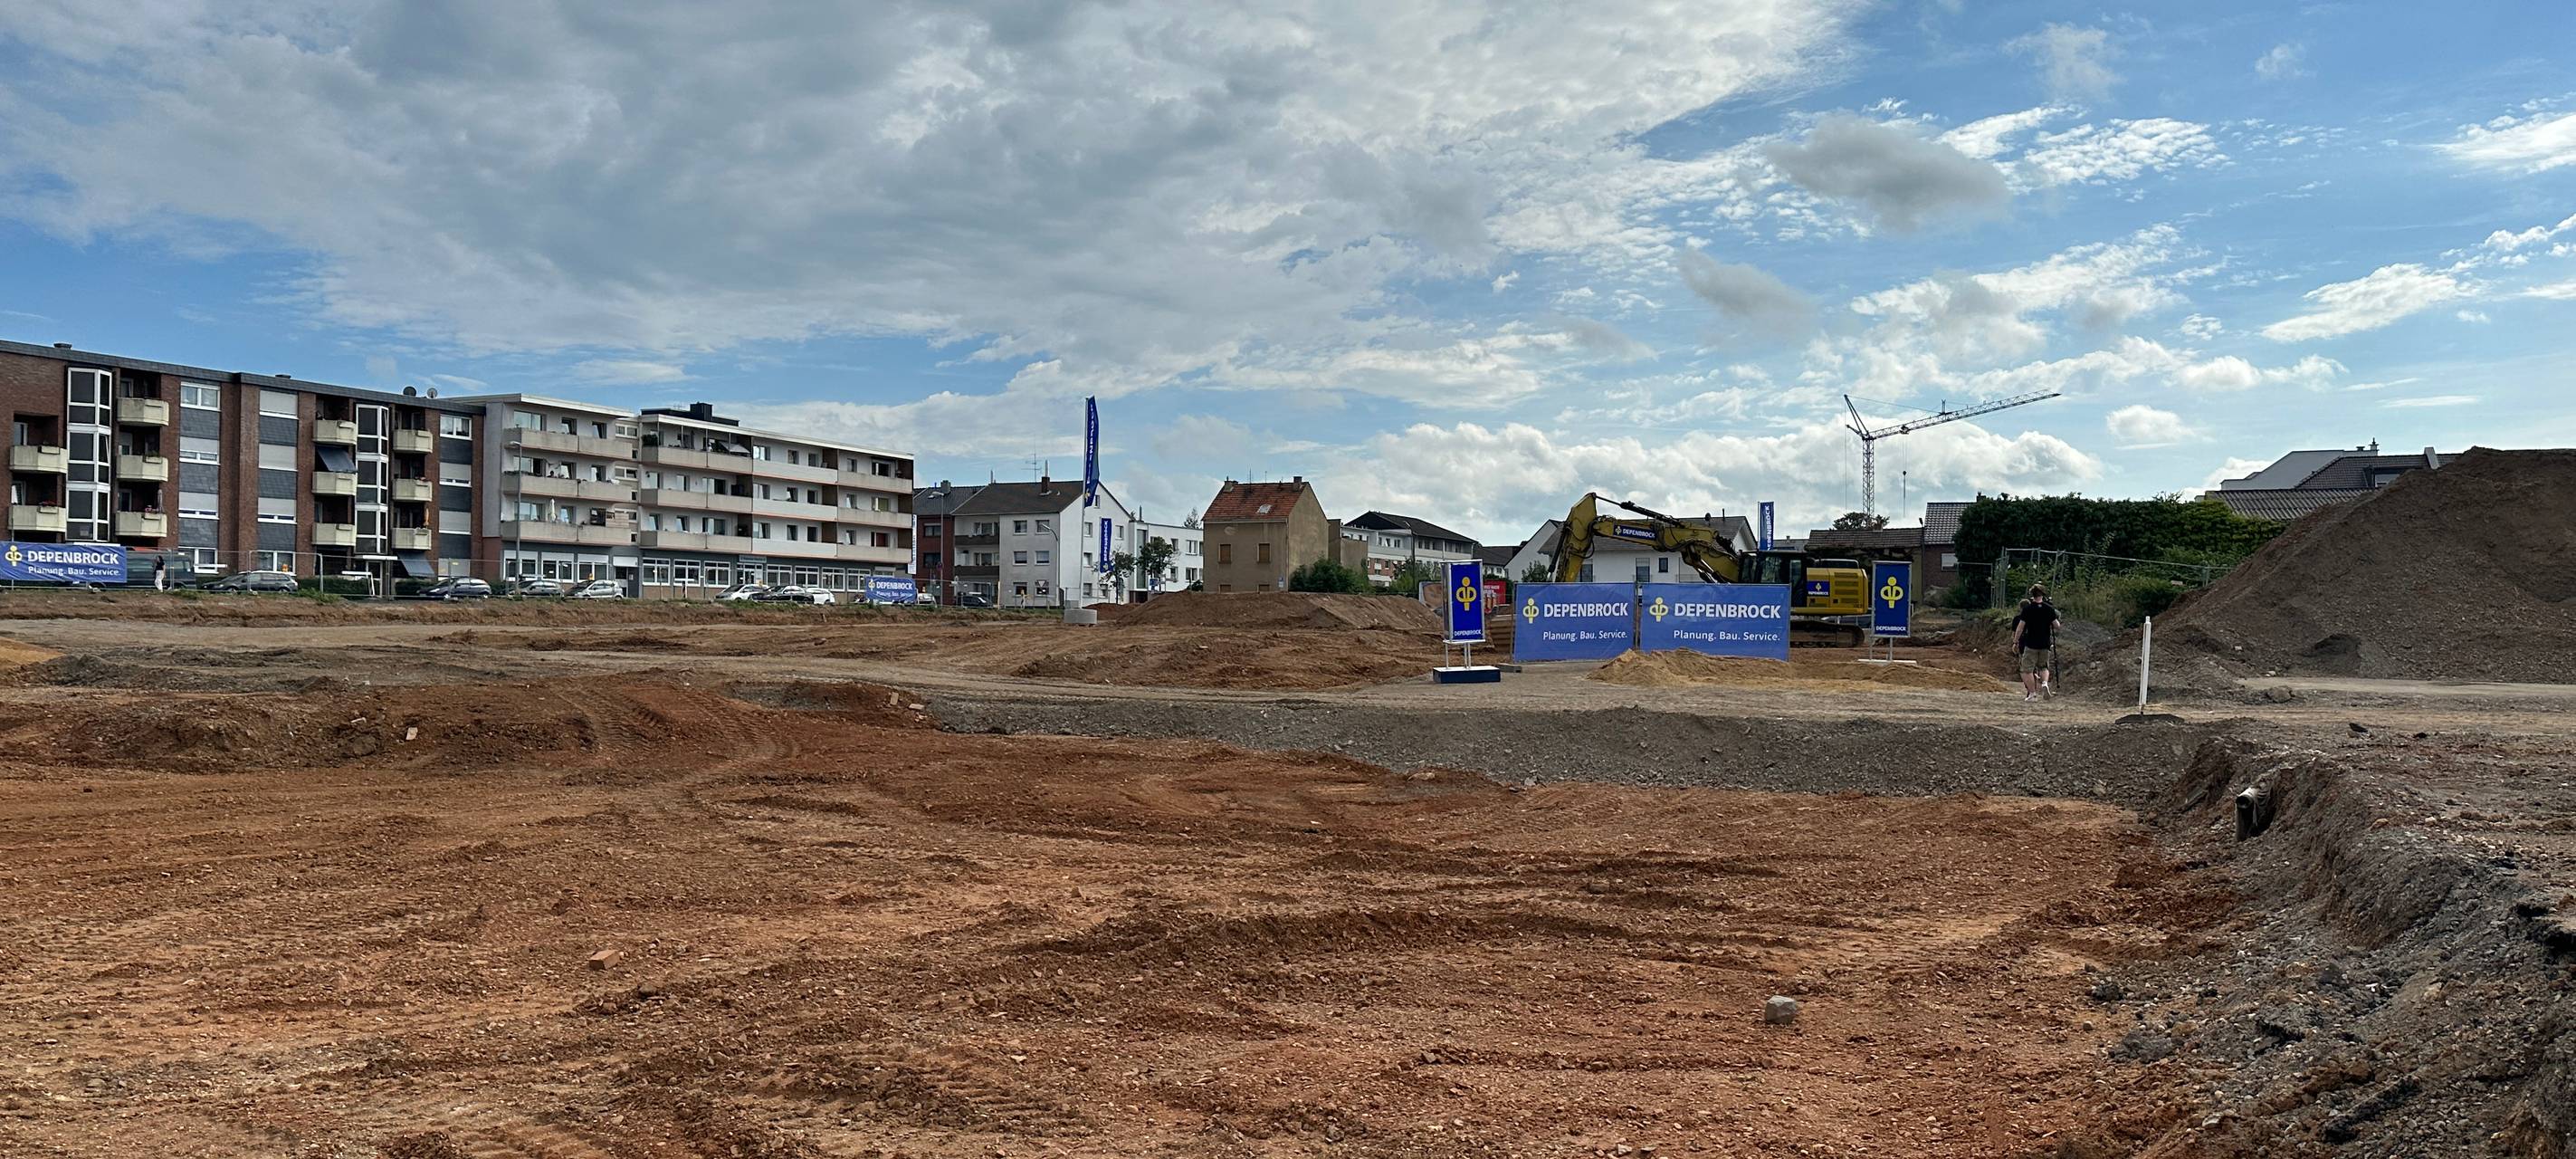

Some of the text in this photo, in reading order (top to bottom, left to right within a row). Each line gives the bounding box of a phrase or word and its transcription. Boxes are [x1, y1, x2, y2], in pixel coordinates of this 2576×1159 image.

[27, 551, 119, 564] DEPENBROCK
[89, 568, 121, 576] Service.
[1543, 602, 1628, 618] DEPENBROCK
[1674, 603, 1780, 618] DEPENBROCK
[1543, 630, 1627, 642] Planung. Bau. Service.
[1674, 630, 1780, 642] Planung. Bau. Service.
